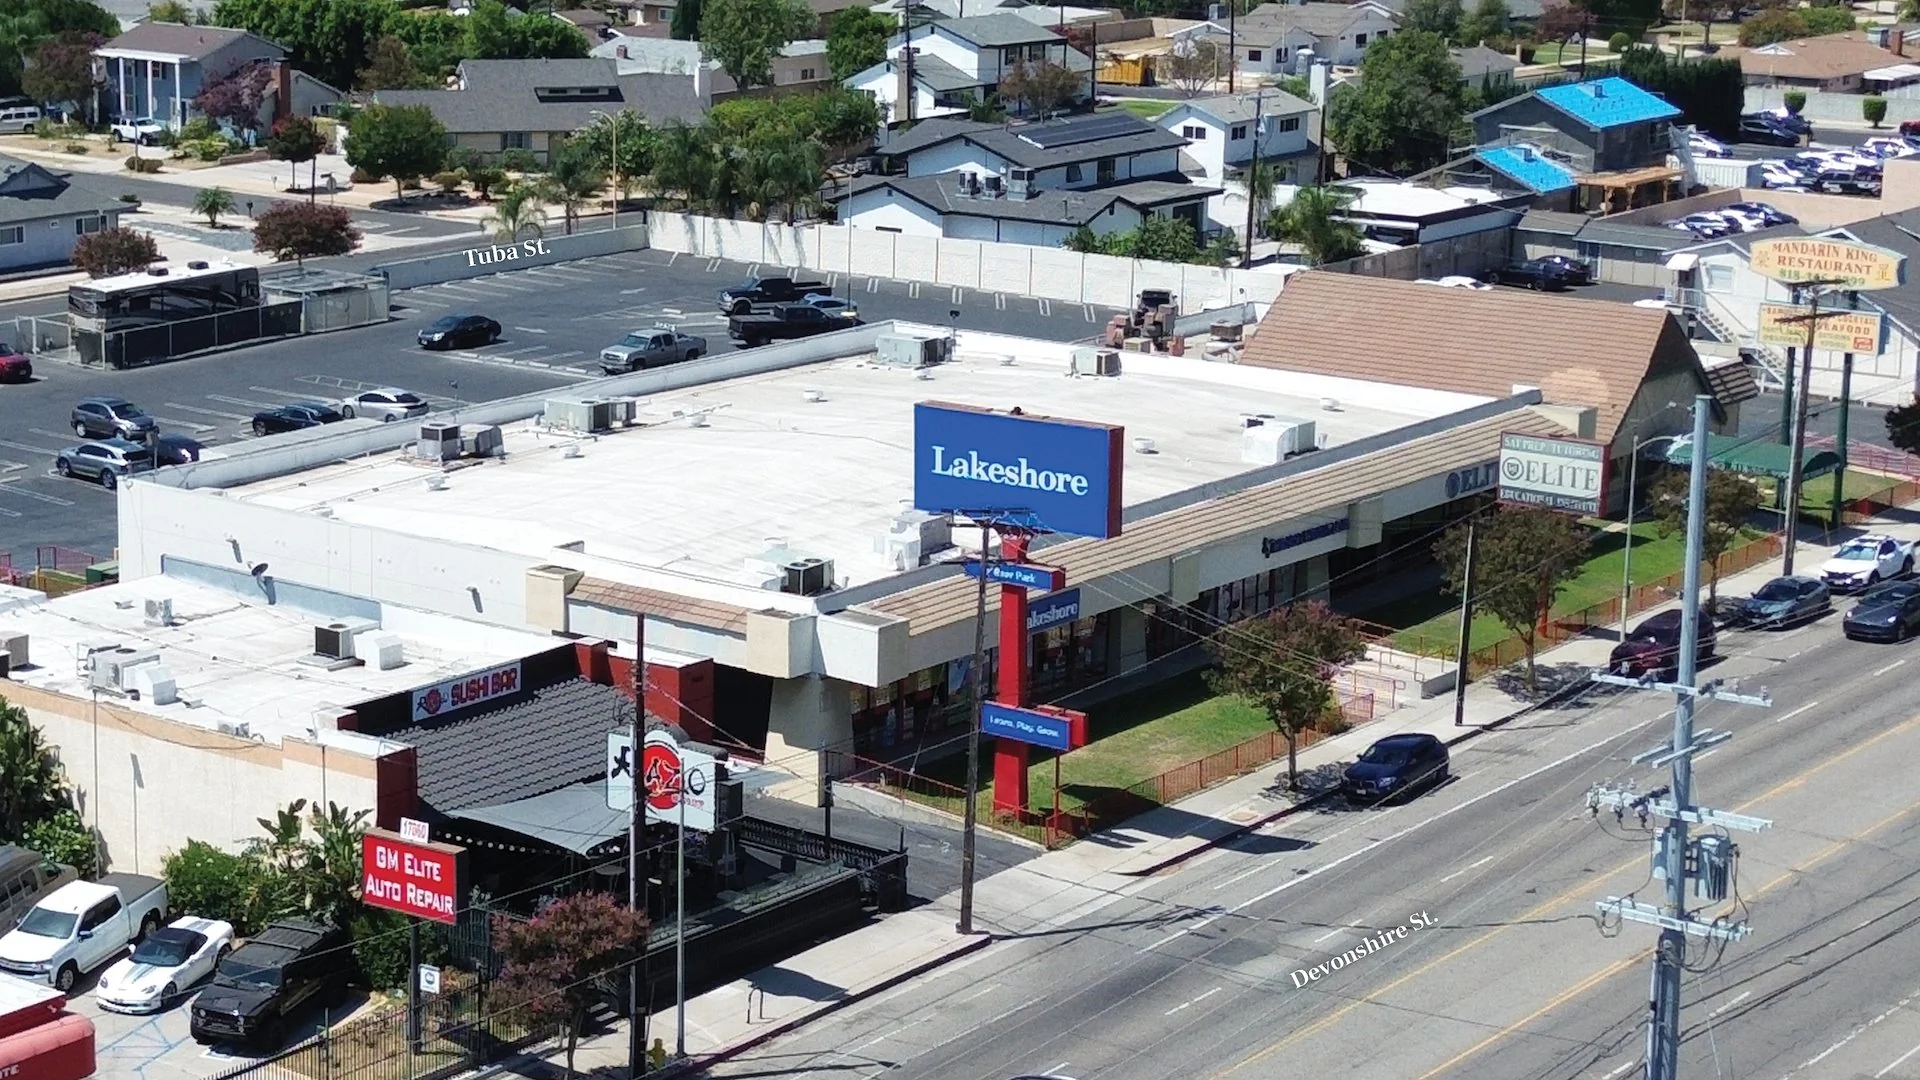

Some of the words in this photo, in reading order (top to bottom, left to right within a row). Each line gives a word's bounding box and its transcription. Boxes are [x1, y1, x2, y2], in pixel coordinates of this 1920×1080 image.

[1772, 242, 1840, 258] MANDARIN
[1845, 249, 1878, 263] KING
[1777, 255, 1872, 275] RESTAURANT
[931, 445, 1089, 496] Lakeshore
[1460, 462, 1499, 493] ELIT
[1525, 459, 1599, 492] ELITE
[1027, 603, 1078, 629] akeshore
[451, 676, 489, 706] SUSHI
[491, 668, 517, 695] BAR
[376, 845, 399, 872] GM
